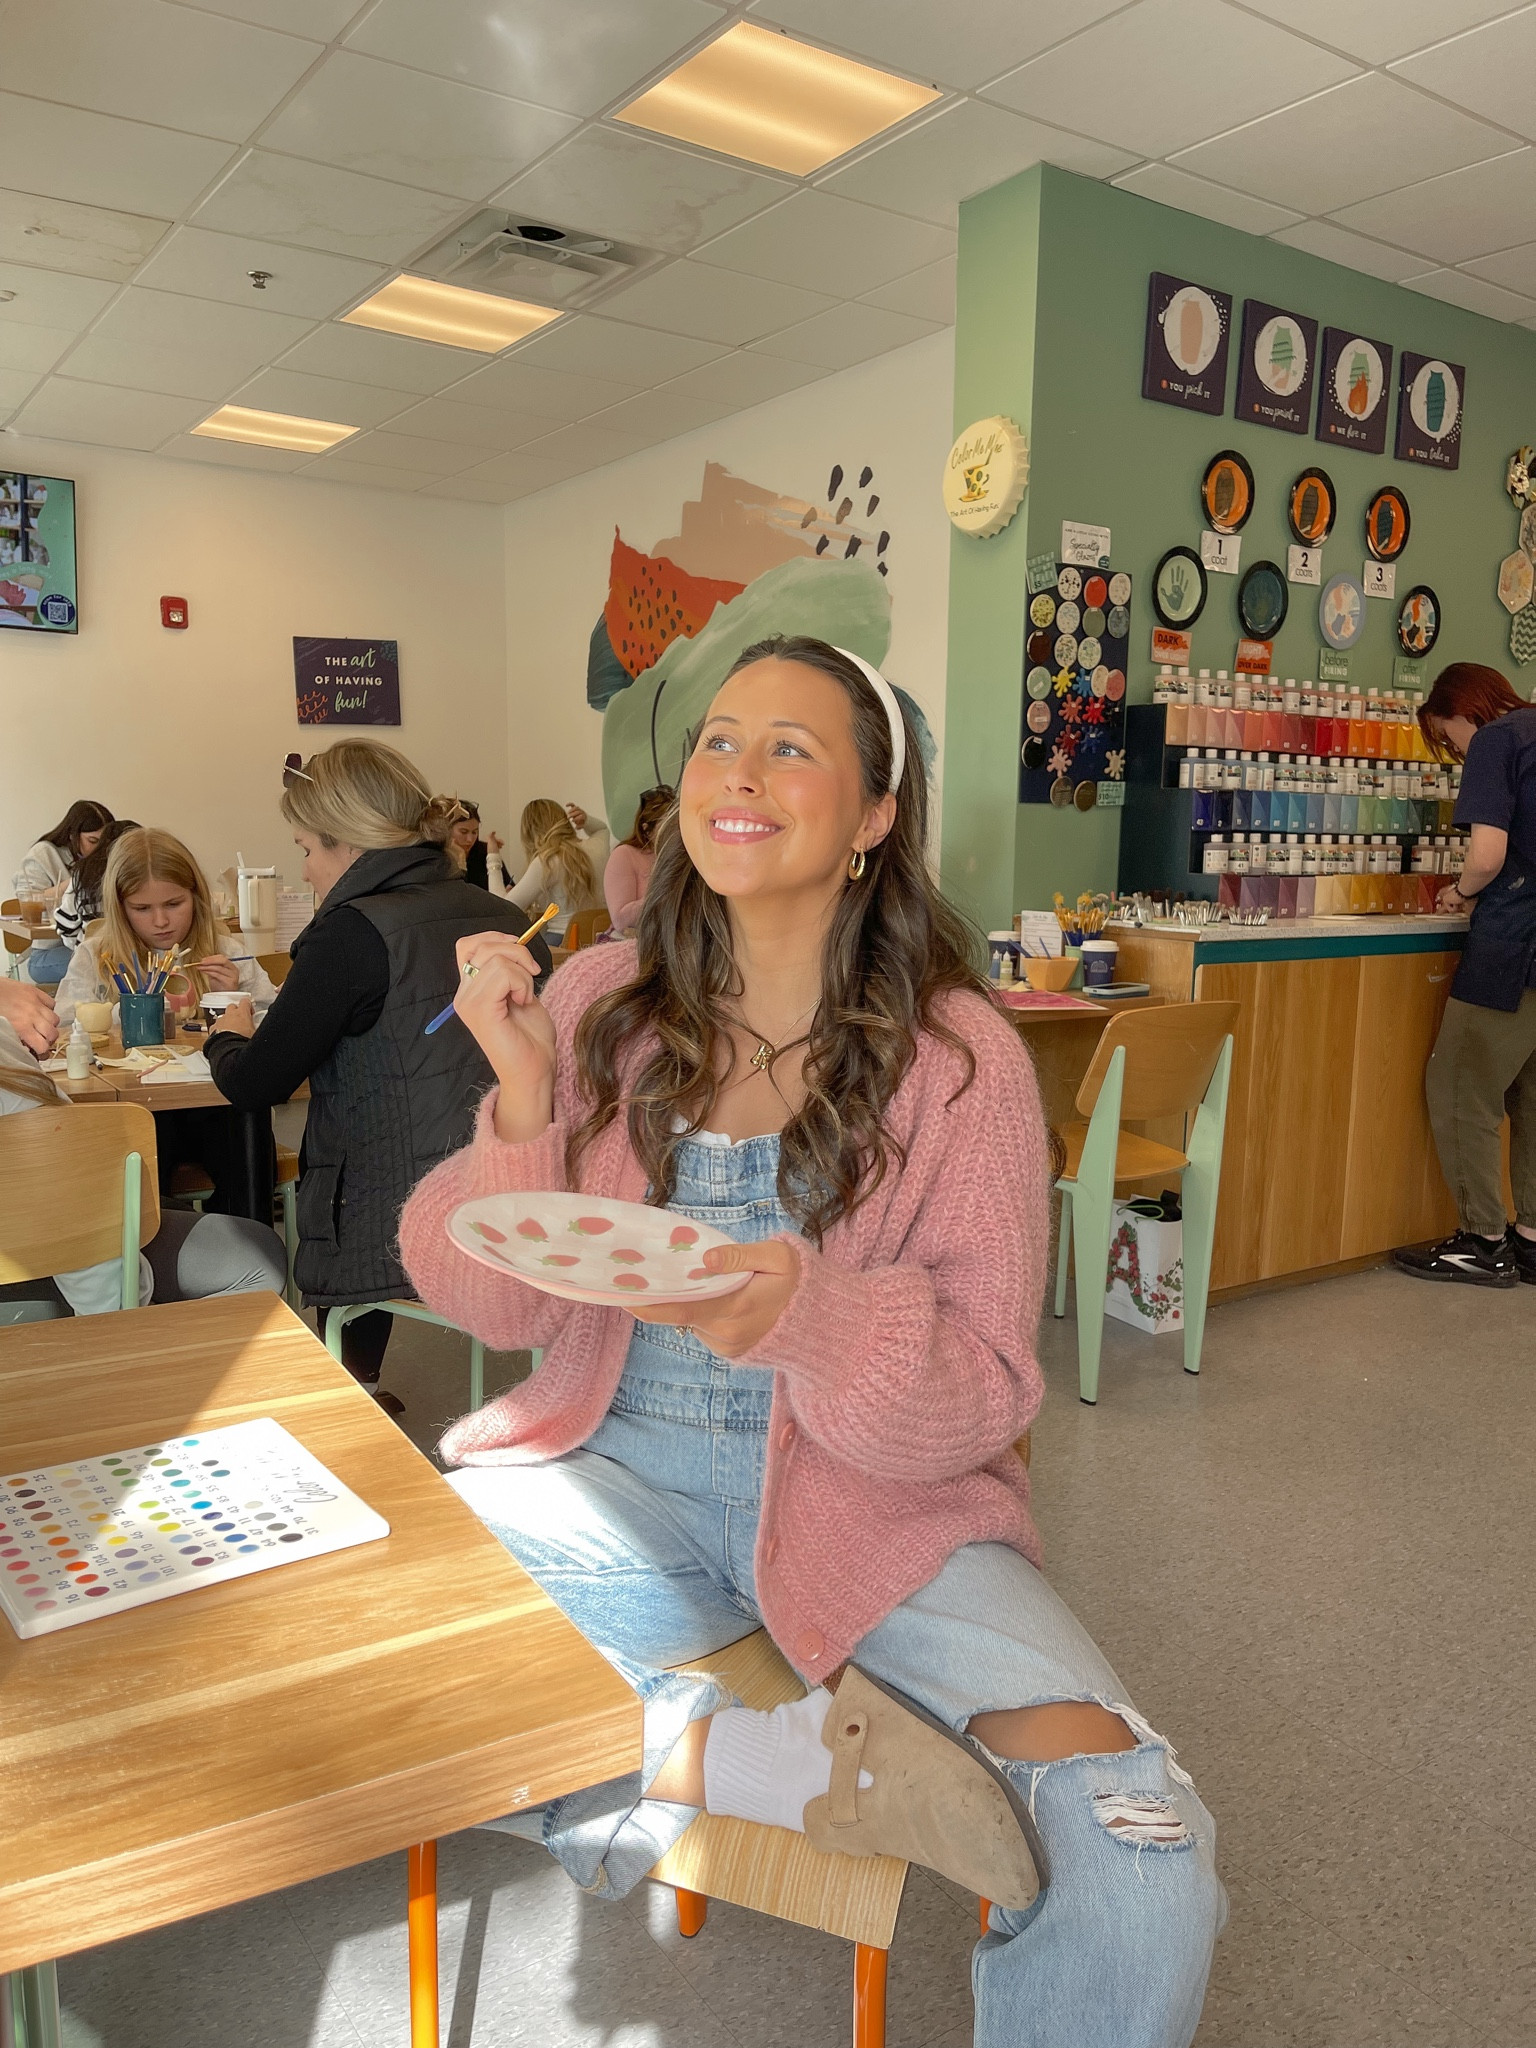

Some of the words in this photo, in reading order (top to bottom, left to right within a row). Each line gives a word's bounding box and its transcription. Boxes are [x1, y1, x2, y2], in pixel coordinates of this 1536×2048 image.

[1169, 382, 1184, 392] YOU
[1261, 406, 1273, 416] YOU
[1336, 427, 1346, 436] WE
[1416, 450, 1428, 458] YOU
[1218, 539, 1223, 555] 1
[1211, 556, 1228, 566] coat
[1301, 552, 1308, 567] 2
[1295, 567, 1313, 578] coats
[1376, 567, 1383, 582] 3
[1370, 583, 1387, 592] coats
[1157, 634, 1179, 646] DARK
[1243, 644, 1262, 654] LIGHT
[325, 657, 347, 666] THE
[350, 648, 376, 668] art
[1325, 652, 1349, 667] before
[1237, 661, 1251, 669] OVER
[1324, 666, 1348, 676] FIRING
[315, 676, 330, 684] OF
[336, 676, 382, 686] HAVING
[1399, 674, 1421, 684] FIRING
[335, 690, 368, 712] fun!
[282, 1480, 338, 1504] Color
[102, 1497, 117, 1505] 72
[162, 1496, 176, 1504] 22
[57, 1507, 71, 1516] 12
[111, 1508, 126, 1516] 21
[280, 1505, 294, 1513] 44
[66, 1520, 80, 1528] 73
[293, 1516, 307, 1525] 70
[130, 1531, 144, 1540] 46
[304, 1527, 319, 1535] 31
[140, 1543, 155, 1552] 10
[92, 1554, 109, 1566] 104
[150, 1554, 166, 1564] 92
[215, 1551, 229, 1560] 83
[103, 1568, 118, 1576] 18
[160, 1565, 177, 1576] 101
[55, 1580, 71, 1590] 86
[113, 1580, 128, 1589] 42
[65, 1594, 80, 1604] 16
